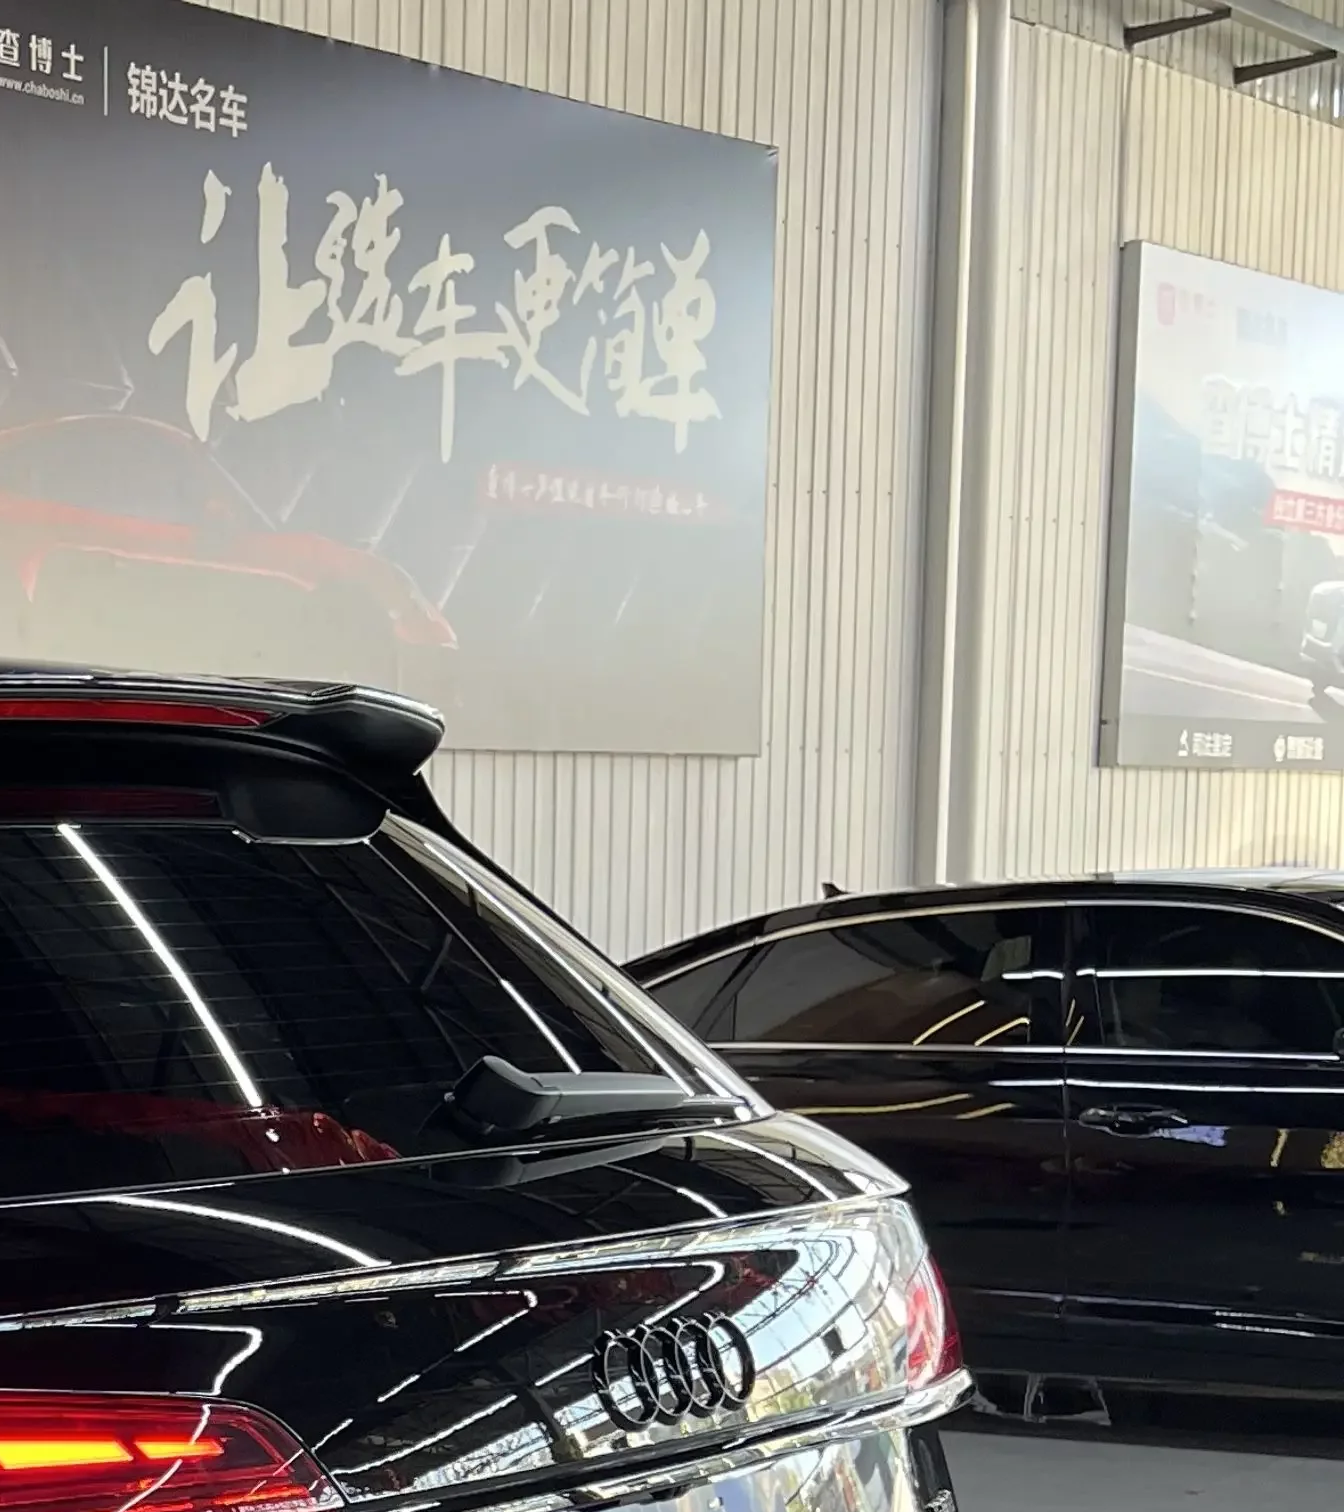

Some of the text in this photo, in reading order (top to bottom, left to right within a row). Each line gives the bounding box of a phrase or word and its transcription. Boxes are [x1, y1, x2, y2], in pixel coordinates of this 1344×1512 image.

[127, 62, 248, 138] 锦达名车
[149, 162, 722, 464] 让选车更简单
